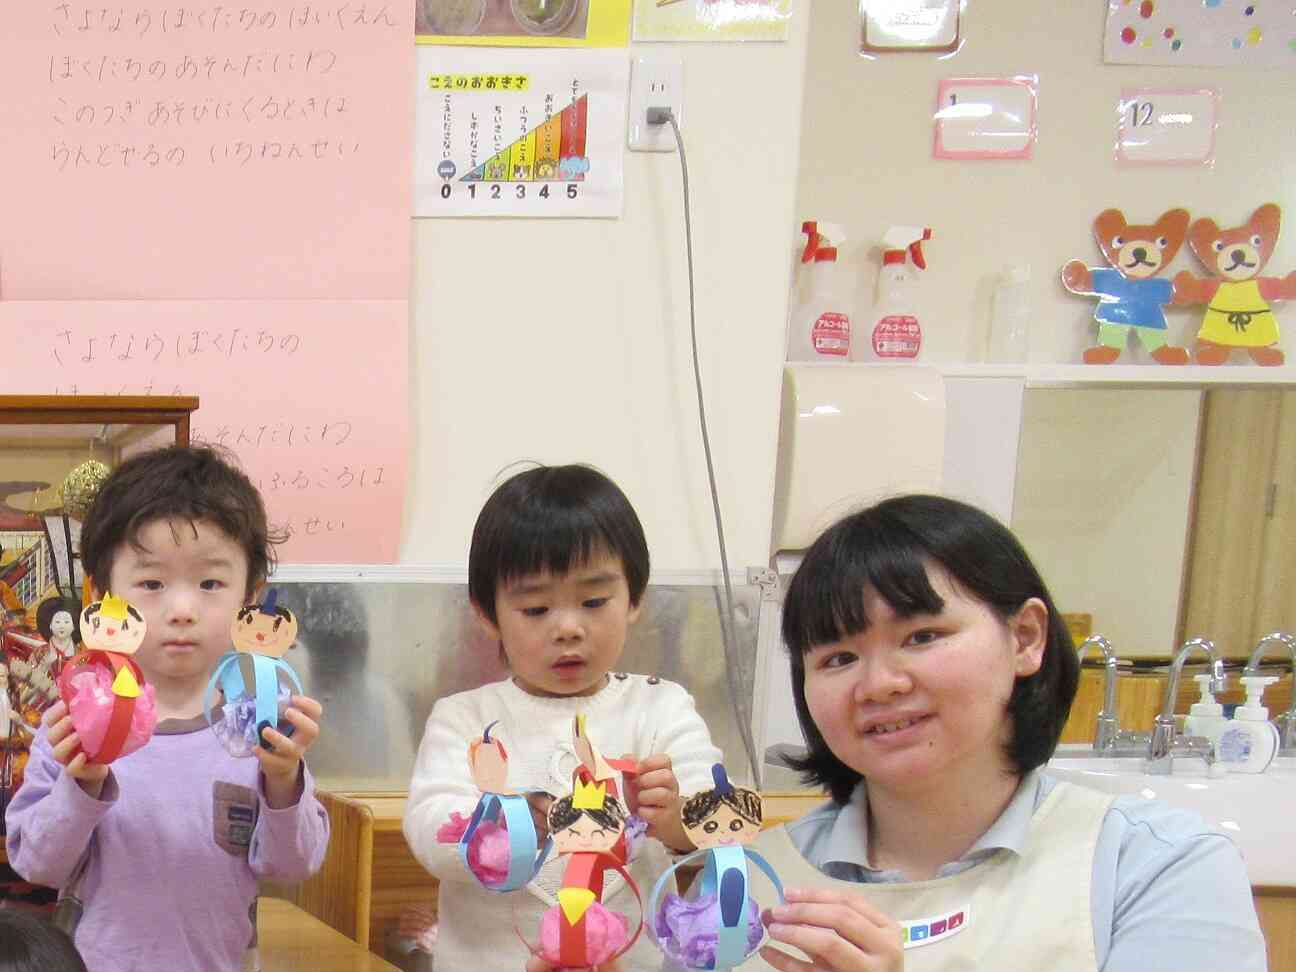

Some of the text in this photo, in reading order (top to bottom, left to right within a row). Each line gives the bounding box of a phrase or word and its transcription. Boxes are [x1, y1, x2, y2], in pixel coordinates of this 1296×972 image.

[431, 75, 528, 89] こえのおおきさ
[1131, 102, 1154, 127] 12
[441, 184, 578, 199] 0 1 2 3 4 5
